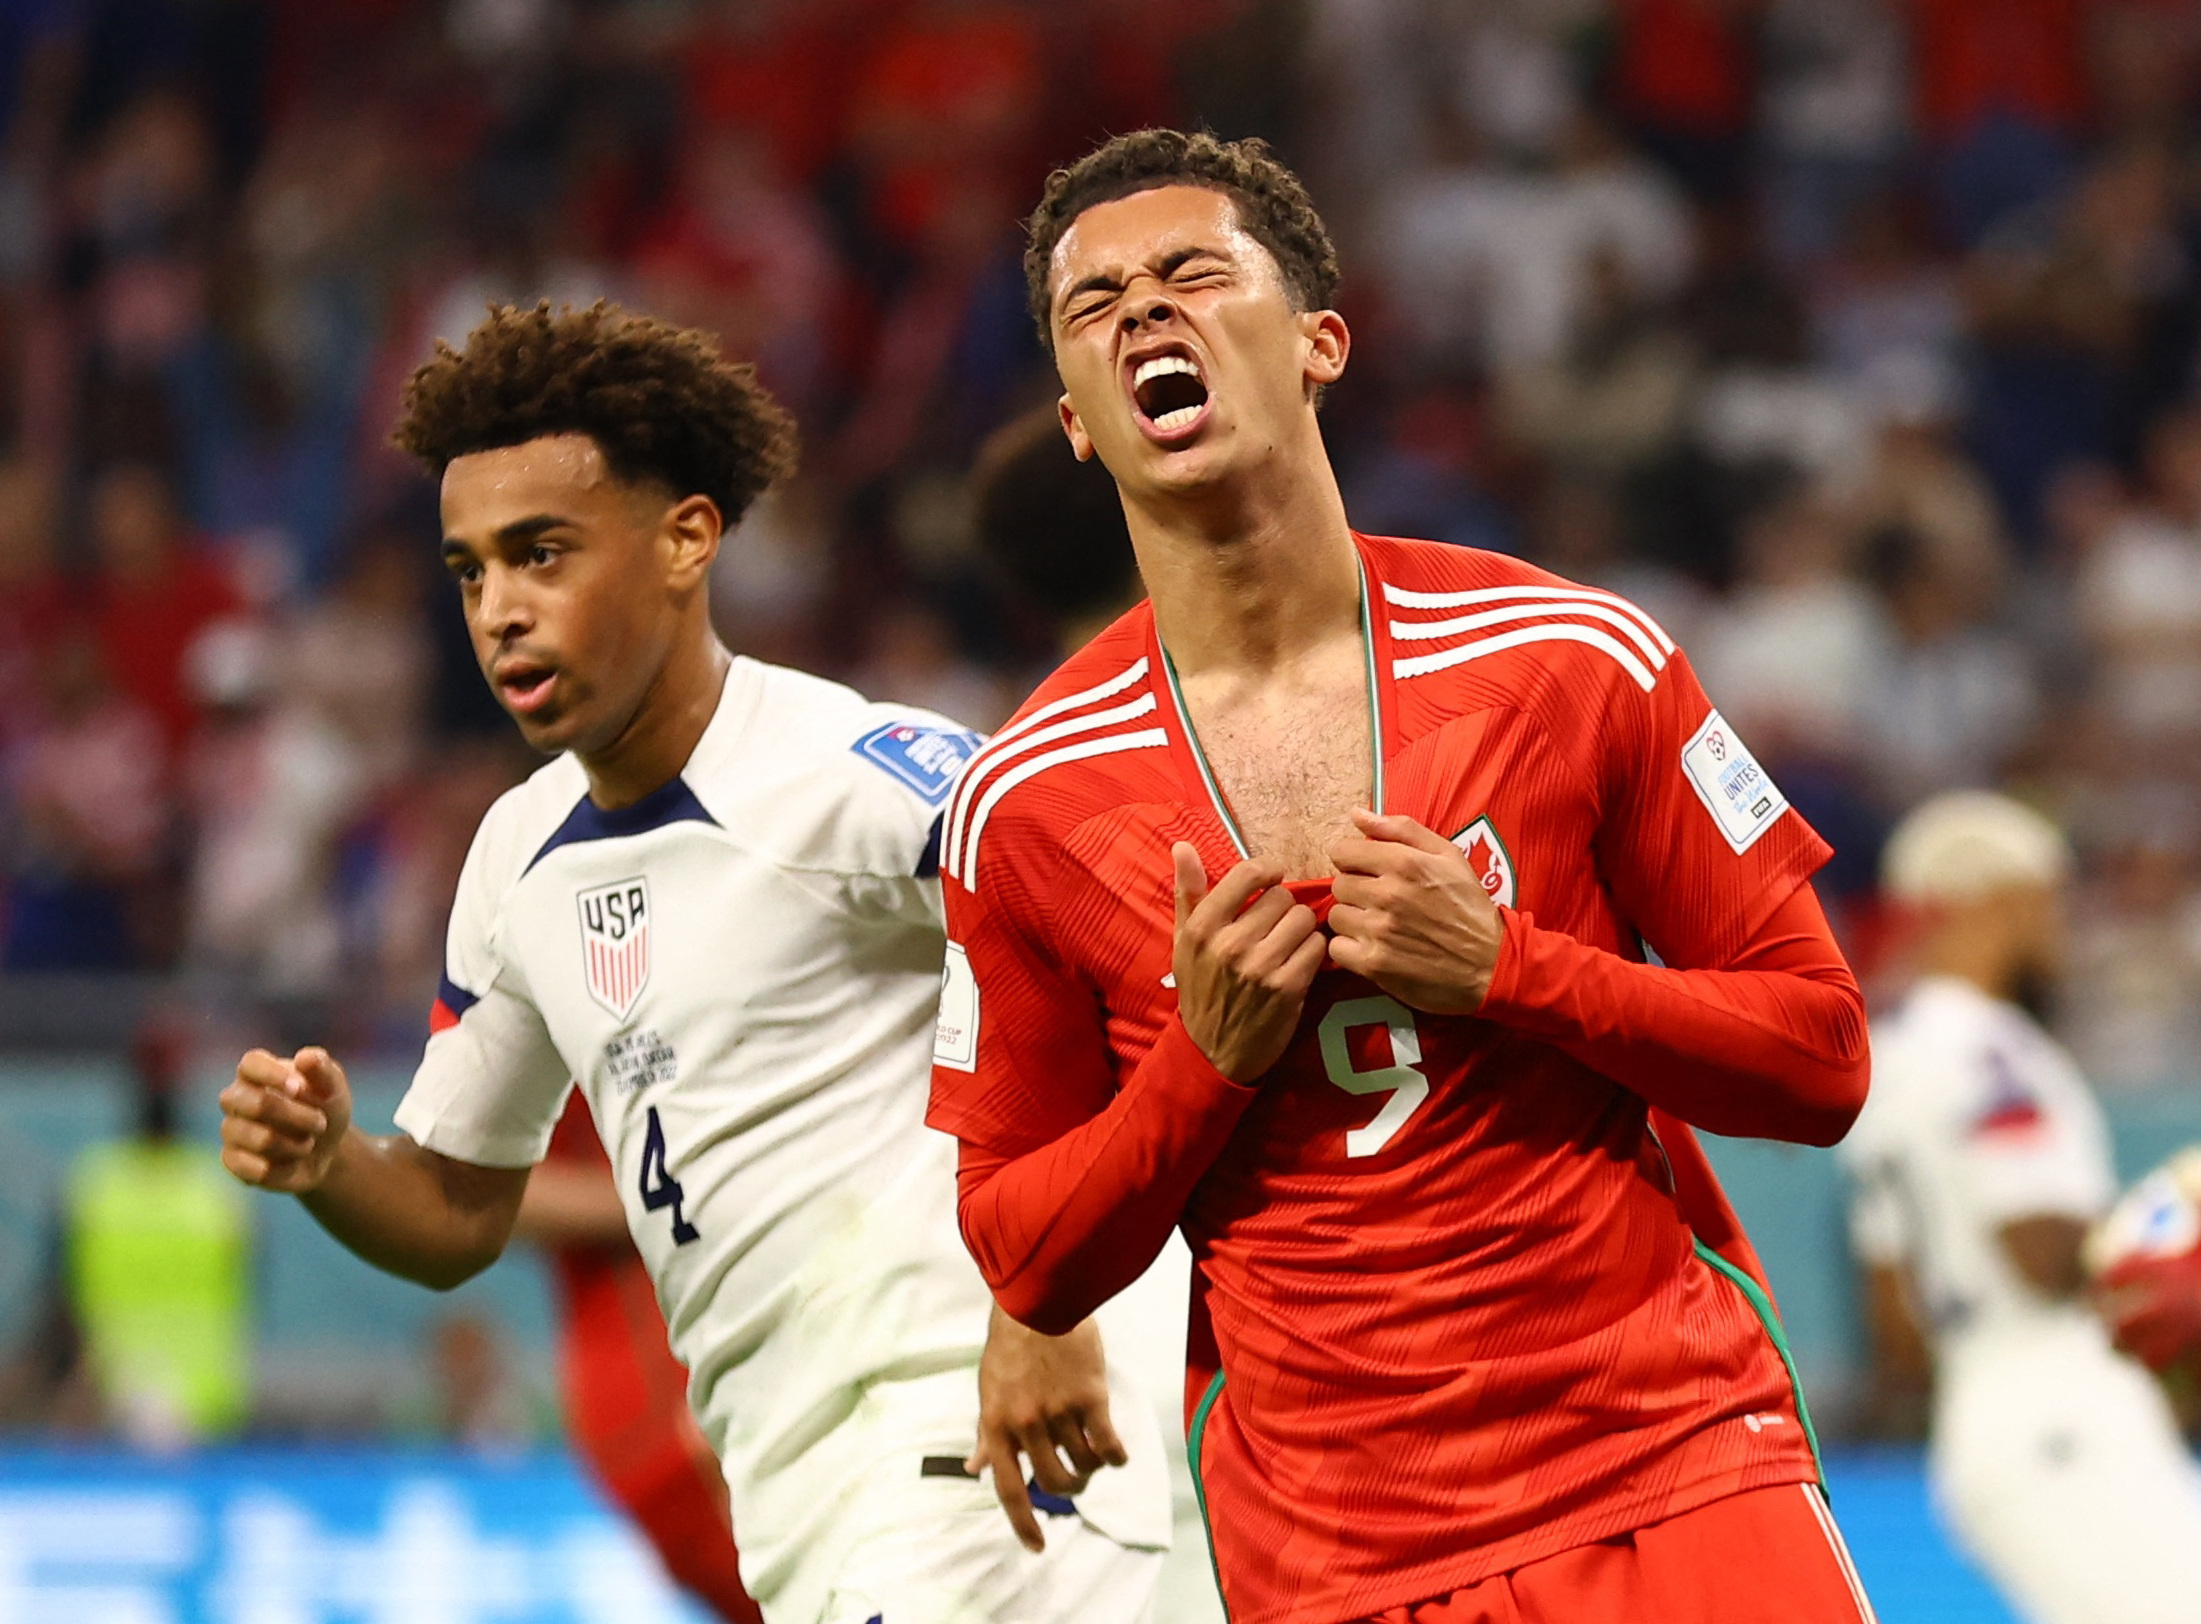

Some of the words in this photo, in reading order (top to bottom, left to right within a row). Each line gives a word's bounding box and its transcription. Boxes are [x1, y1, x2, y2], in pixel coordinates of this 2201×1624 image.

[1724, 763, 1758, 800] UNITES
[585, 886, 645, 941] USA
[1318, 994, 1430, 1159] 9
[639, 1104, 701, 1246] 4
